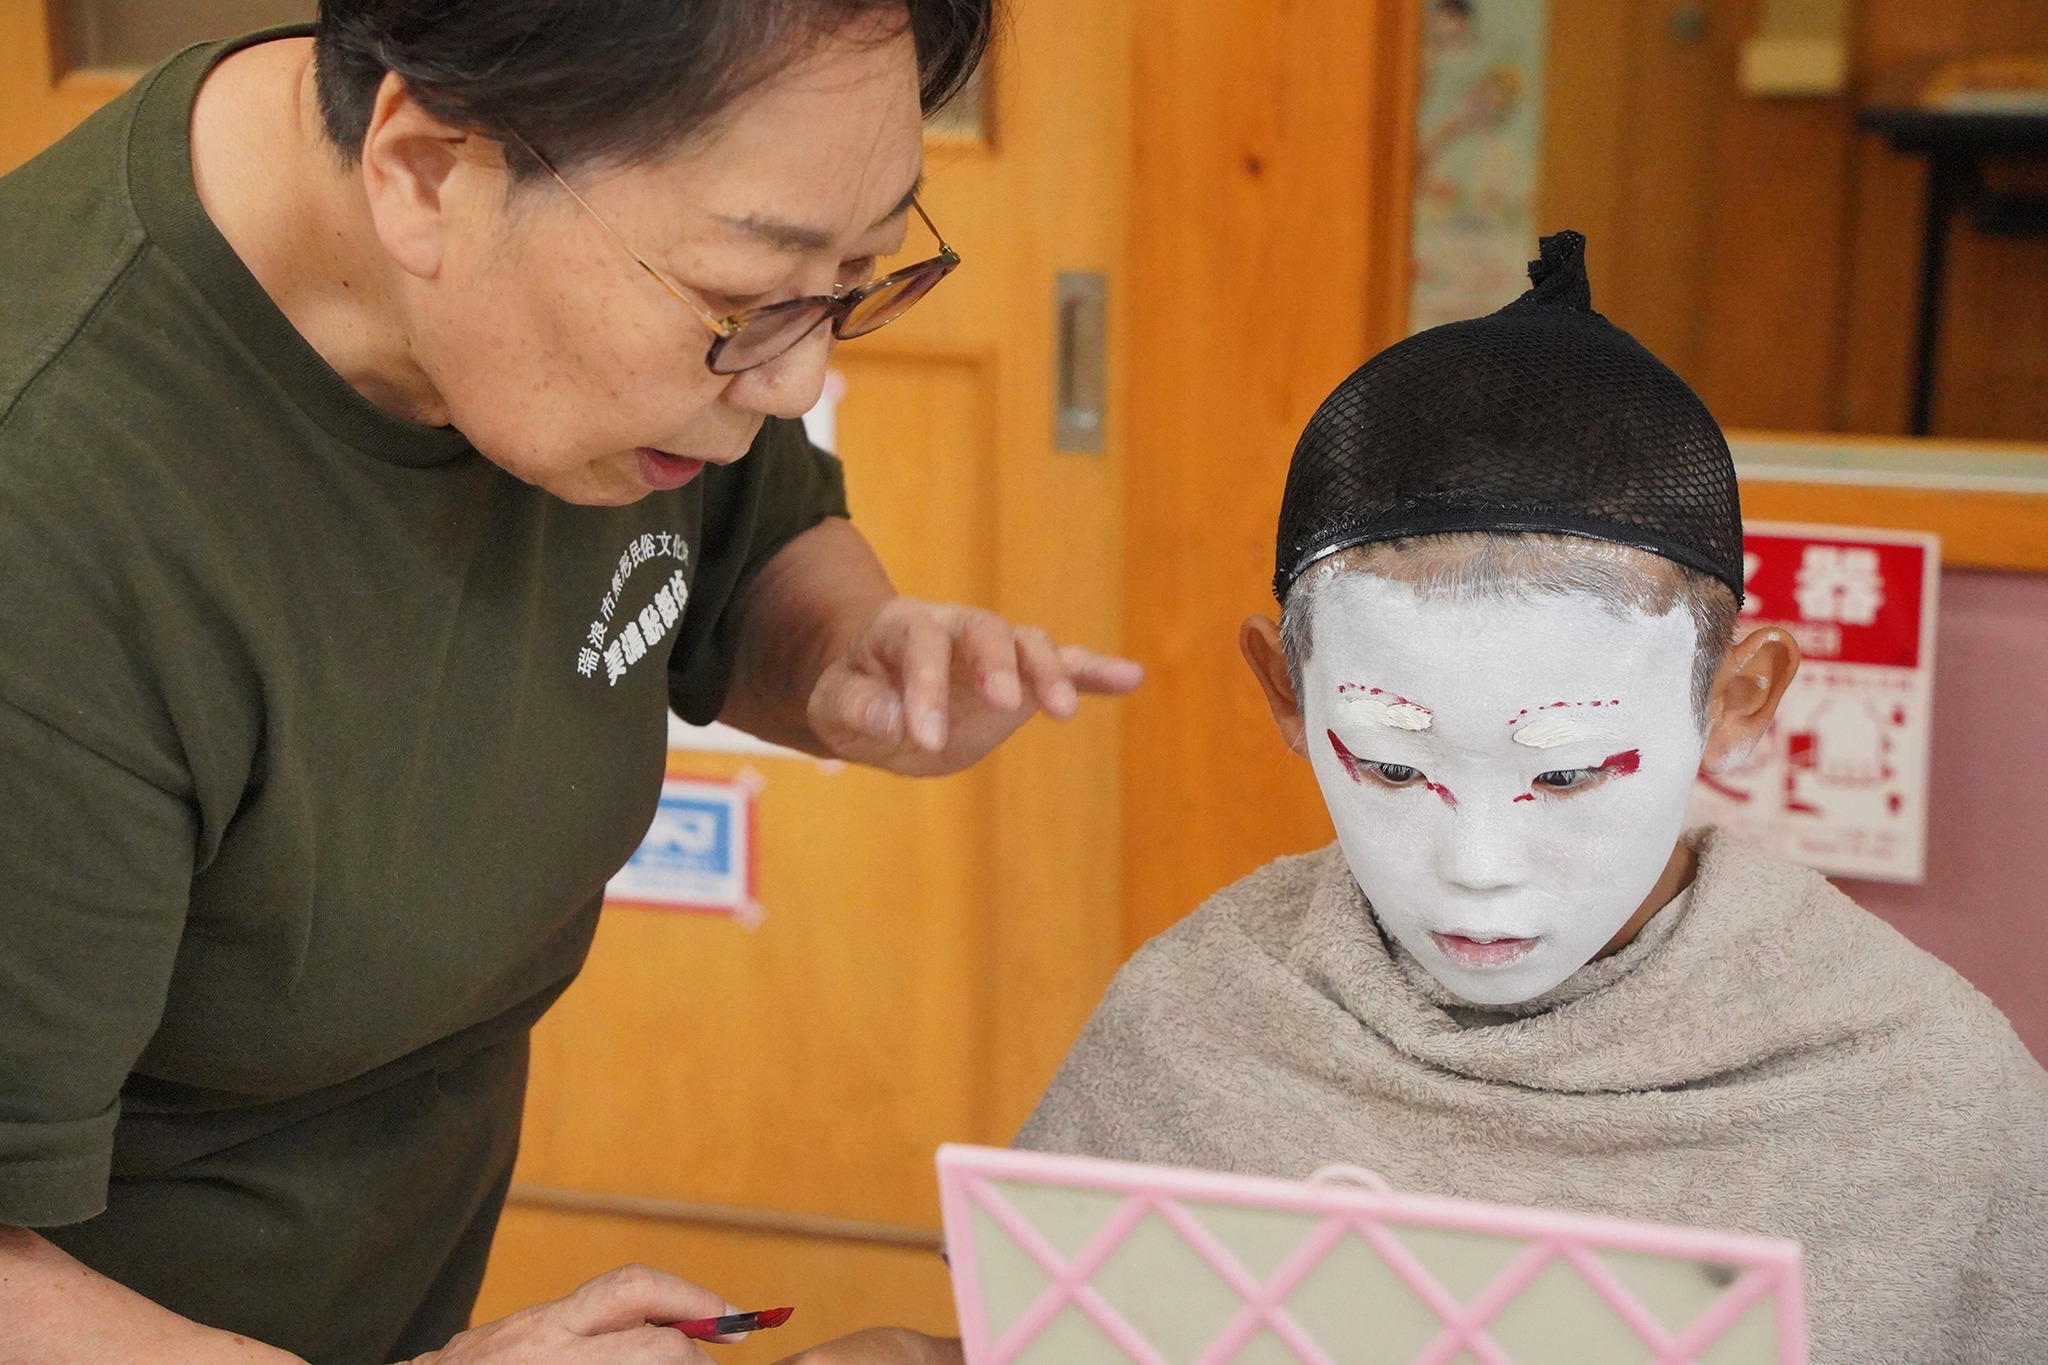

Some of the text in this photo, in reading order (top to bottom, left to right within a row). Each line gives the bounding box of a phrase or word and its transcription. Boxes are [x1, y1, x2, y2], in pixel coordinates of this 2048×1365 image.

[577, 530, 690, 679] 瑞浪市無形民俗文化
[1743, 544, 1888, 626] 器
